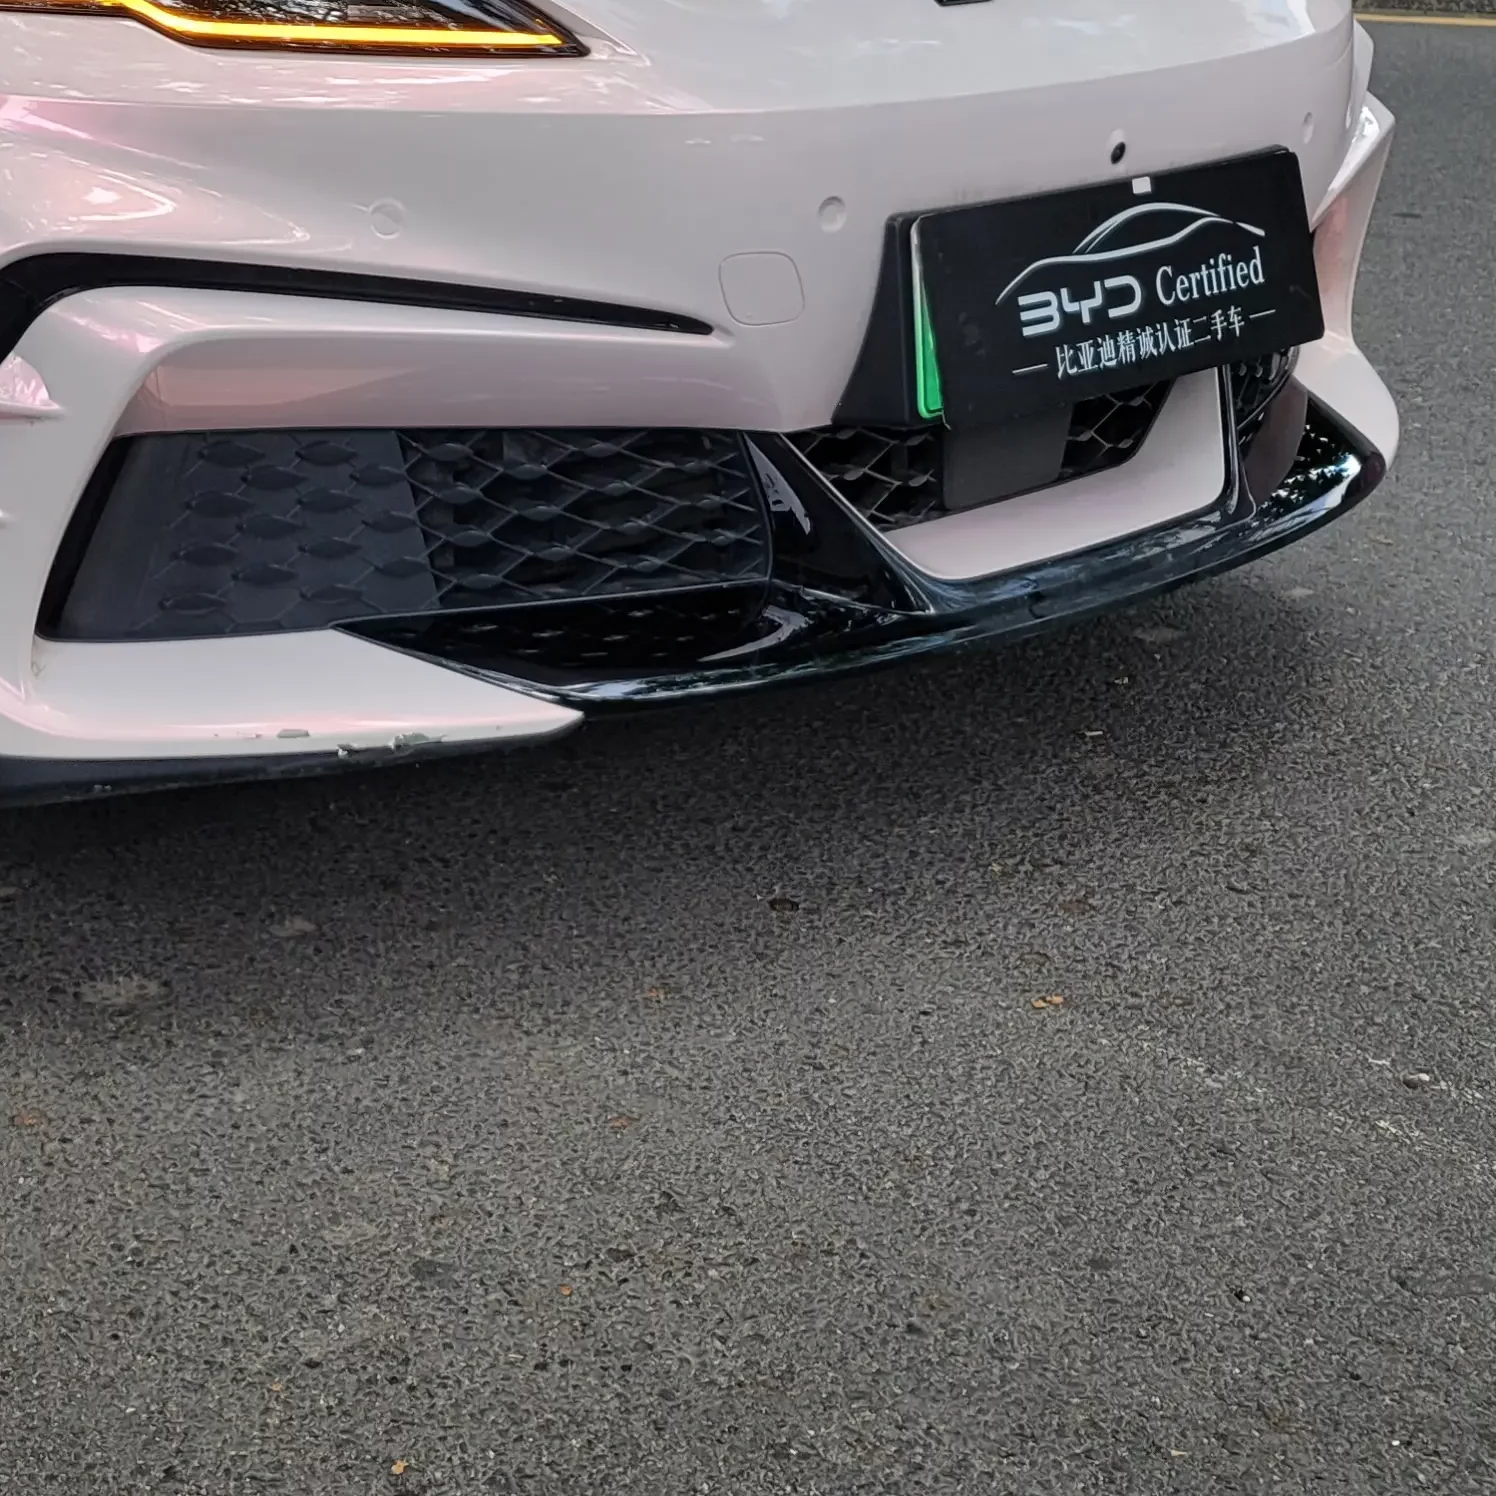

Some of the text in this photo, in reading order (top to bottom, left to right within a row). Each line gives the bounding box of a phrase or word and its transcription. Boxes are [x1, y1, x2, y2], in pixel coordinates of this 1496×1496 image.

[1017, 245, 1265, 337] BYD Certified
[1055, 305, 1246, 380] 比亚迪精诚认证二手车
